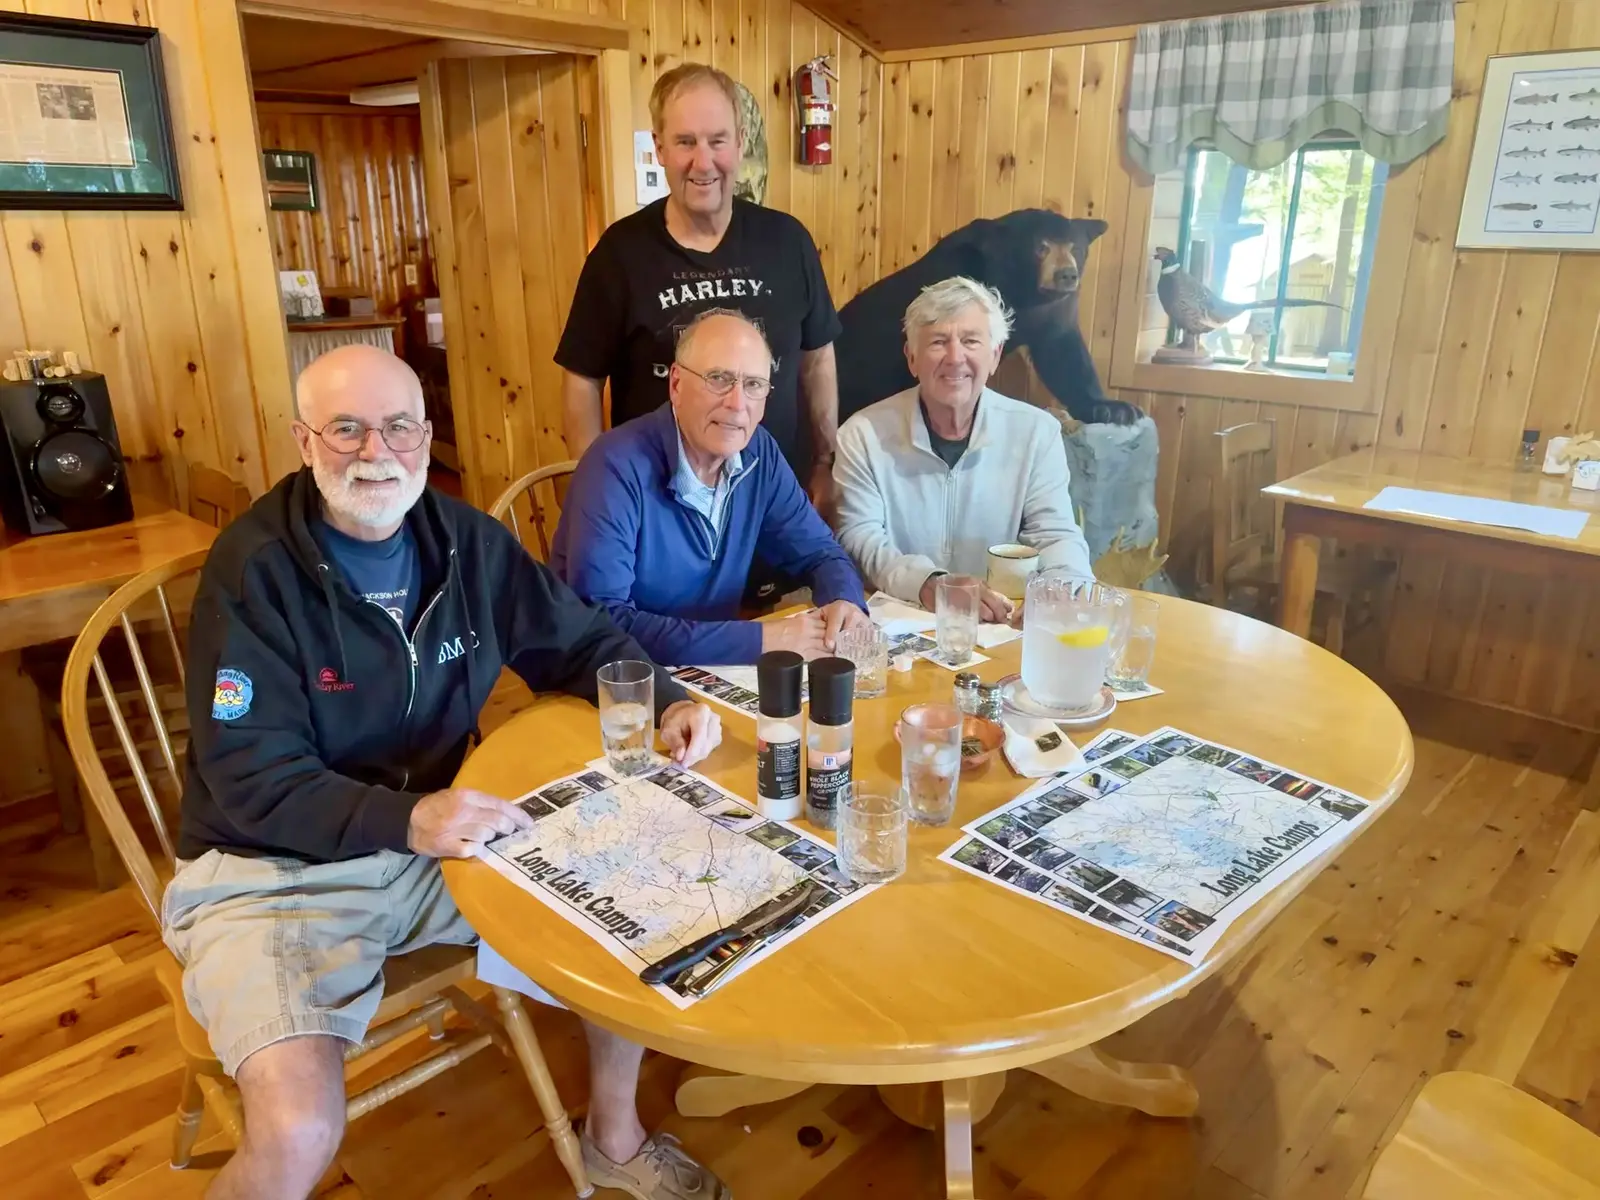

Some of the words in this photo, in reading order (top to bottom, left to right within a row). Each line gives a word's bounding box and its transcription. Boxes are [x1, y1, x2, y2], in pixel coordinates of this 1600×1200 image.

[513, 846, 561, 882] Long
[547, 870, 595, 904] Lake
[584, 896, 648, 941] Camps
[1200, 867, 1261, 897] Long
[1231, 846, 1283, 873] Lake
[1262, 820, 1321, 851] Camps
